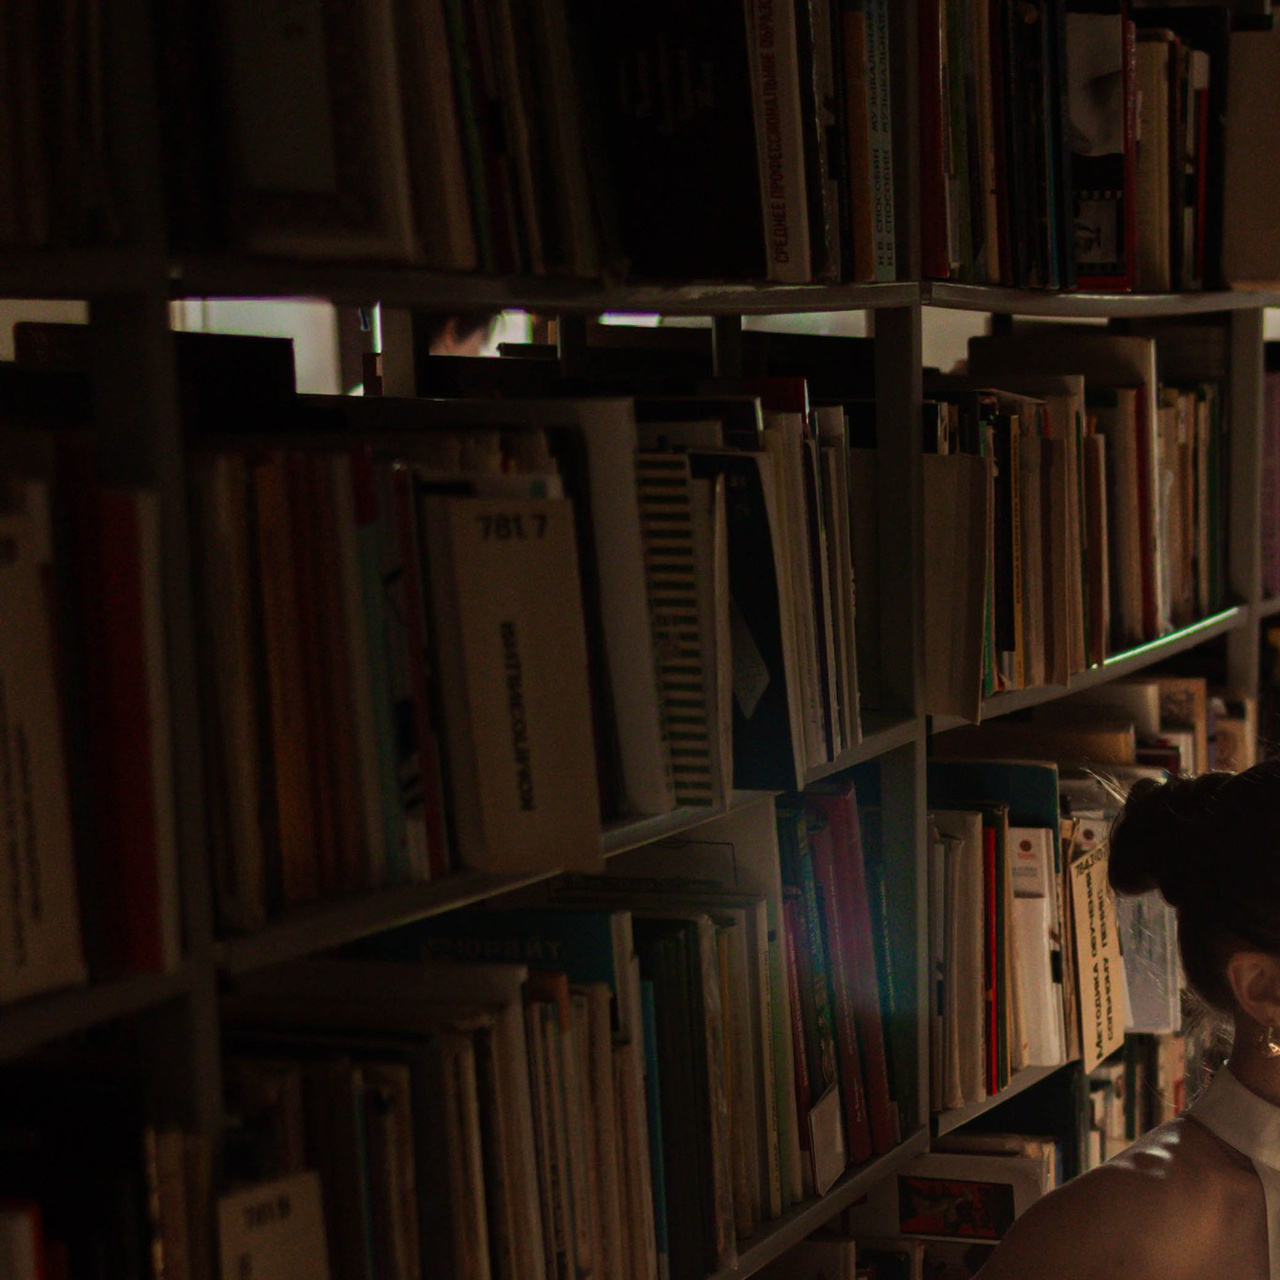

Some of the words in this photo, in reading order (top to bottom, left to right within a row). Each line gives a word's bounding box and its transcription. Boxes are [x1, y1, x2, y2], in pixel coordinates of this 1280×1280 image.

[762, 53, 786, 200] ПРОФЕССИОНАЛЬНОЕ
[772, 203, 789, 264] СРЕДНЕЕ
[1085, 872, 1098, 958] ОБУЧЕНИЯ
[1093, 962, 1105, 1061] МЕТОДИКА
[1101, 957, 1115, 1041] СОЛЬНОМУ
